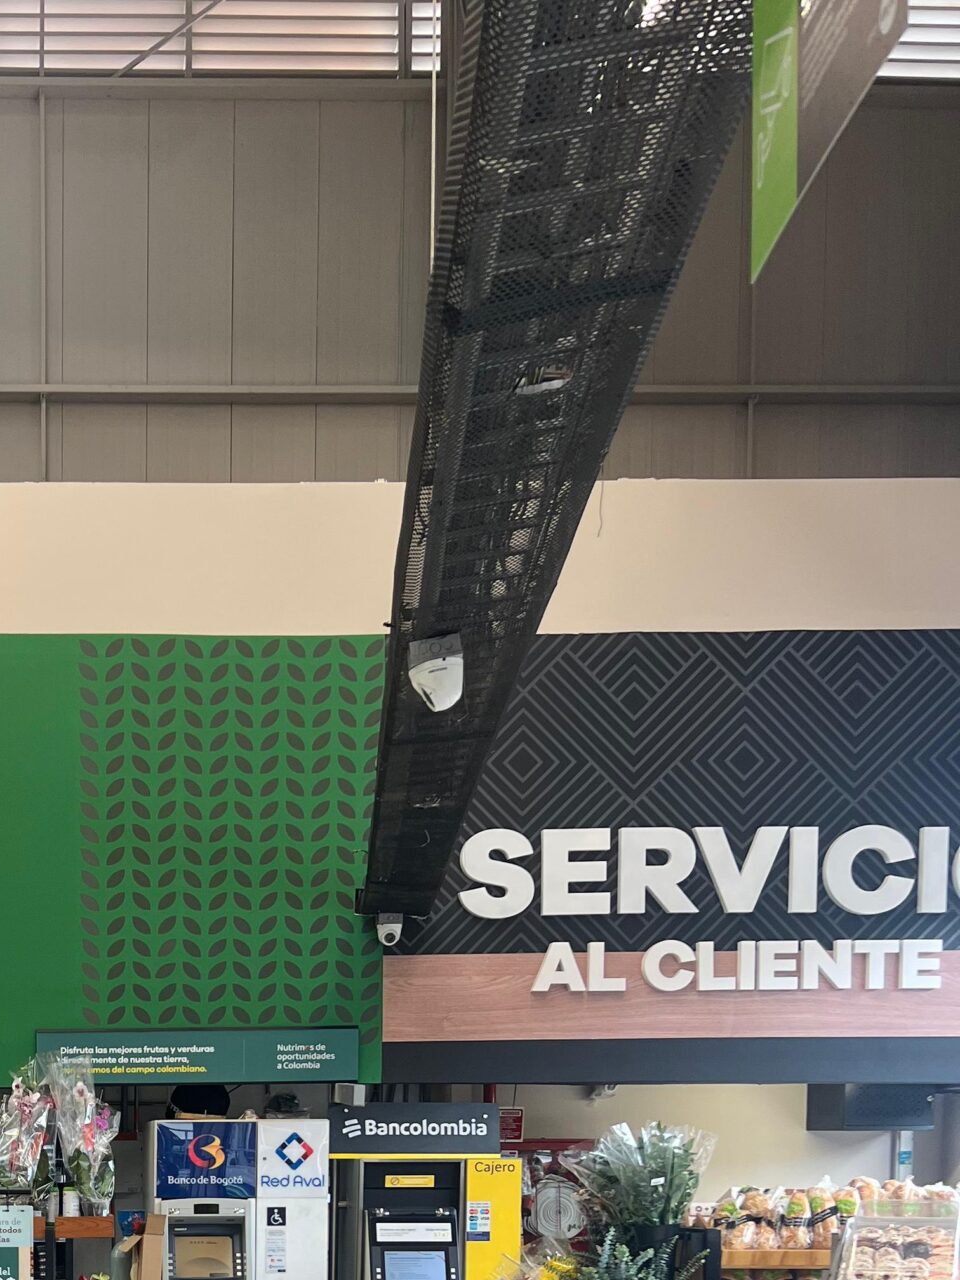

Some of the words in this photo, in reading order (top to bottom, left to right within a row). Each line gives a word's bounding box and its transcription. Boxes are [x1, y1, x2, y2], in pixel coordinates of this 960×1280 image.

[457, 826, 960, 920] SERVICI
[531, 941, 626, 992] AL
[642, 939, 943, 992] CLIENTE
[61, 1047, 94, 1055] Disfruta
[95, 1046, 107, 1054] las
[109, 1046, 141, 1055] mejores
[143, 1046, 169, 1054] frutas
[177, 1045, 214, 1053] verduras
[61, 1056, 117, 1064] direcmente
[164, 1055, 190, 1064] tierra,
[277, 1052, 335, 1061] oportunidades
[283, 1061, 320, 1069] Colombia
[112, 1066, 124, 1074] del
[126, 1067, 155, 1075] campo
[364, 1119, 488, 1136] Bancolombia
[474, 1161, 515, 1175] Cajero
[168, 1176, 196, 1184] Banco
[197, 1176, 209, 1184] de
[210, 1176, 243, 1186] Bogotá
[261, 1175, 290, 1187] Red
[293, 1175, 325, 1187] Aval
